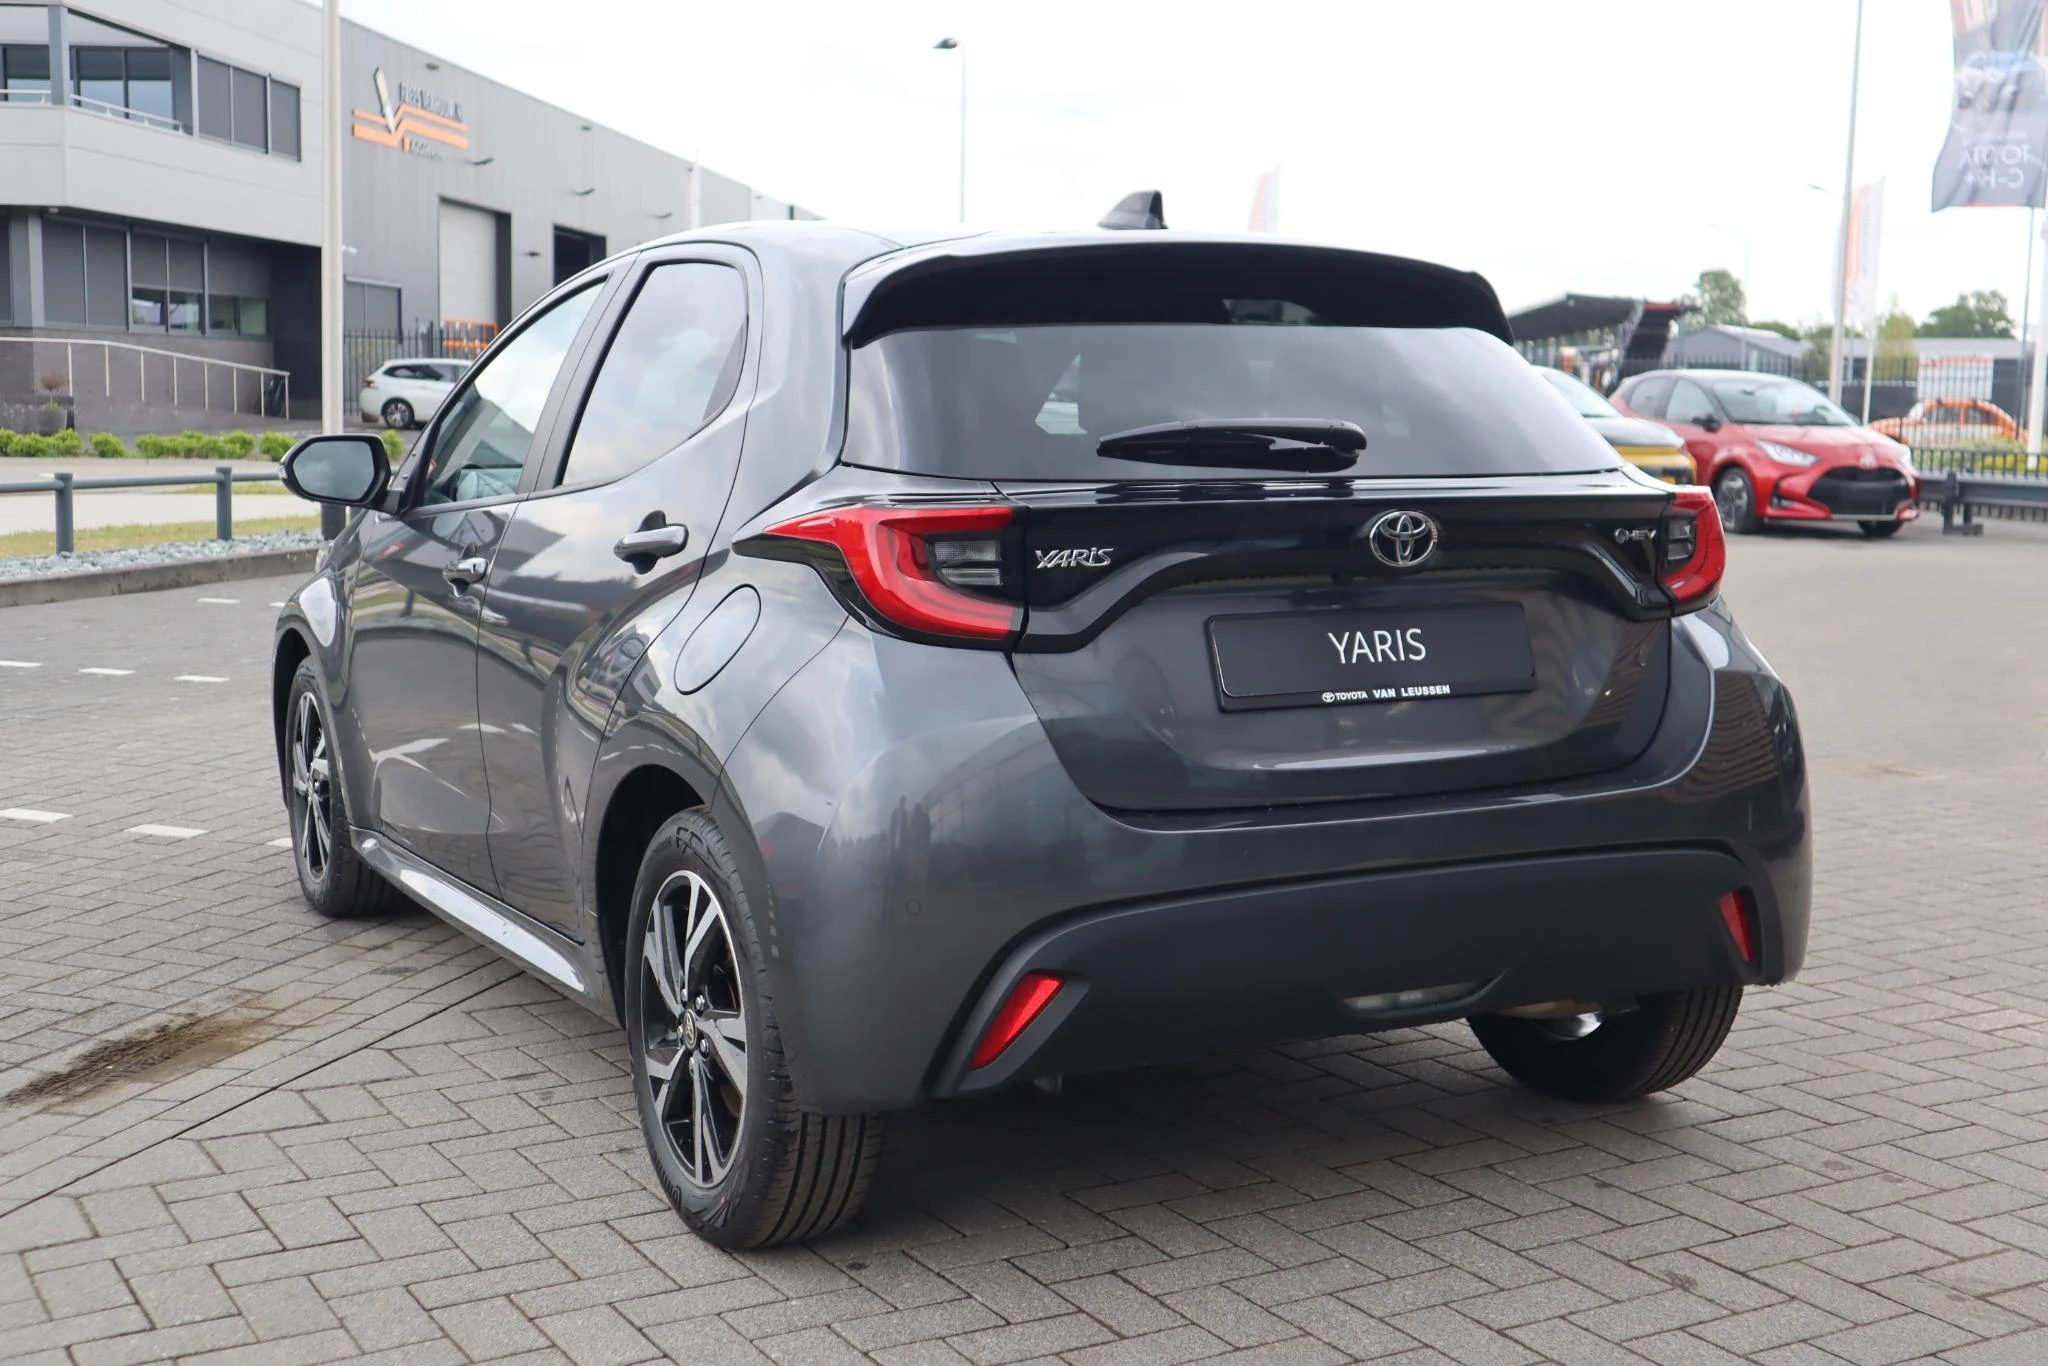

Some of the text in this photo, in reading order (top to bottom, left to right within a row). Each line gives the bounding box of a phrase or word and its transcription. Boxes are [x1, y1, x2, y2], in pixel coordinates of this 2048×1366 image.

[1327, 628, 1427, 664] YARIS
[1335, 684, 1451, 701] TOYOTA VAN LEUSSEN
